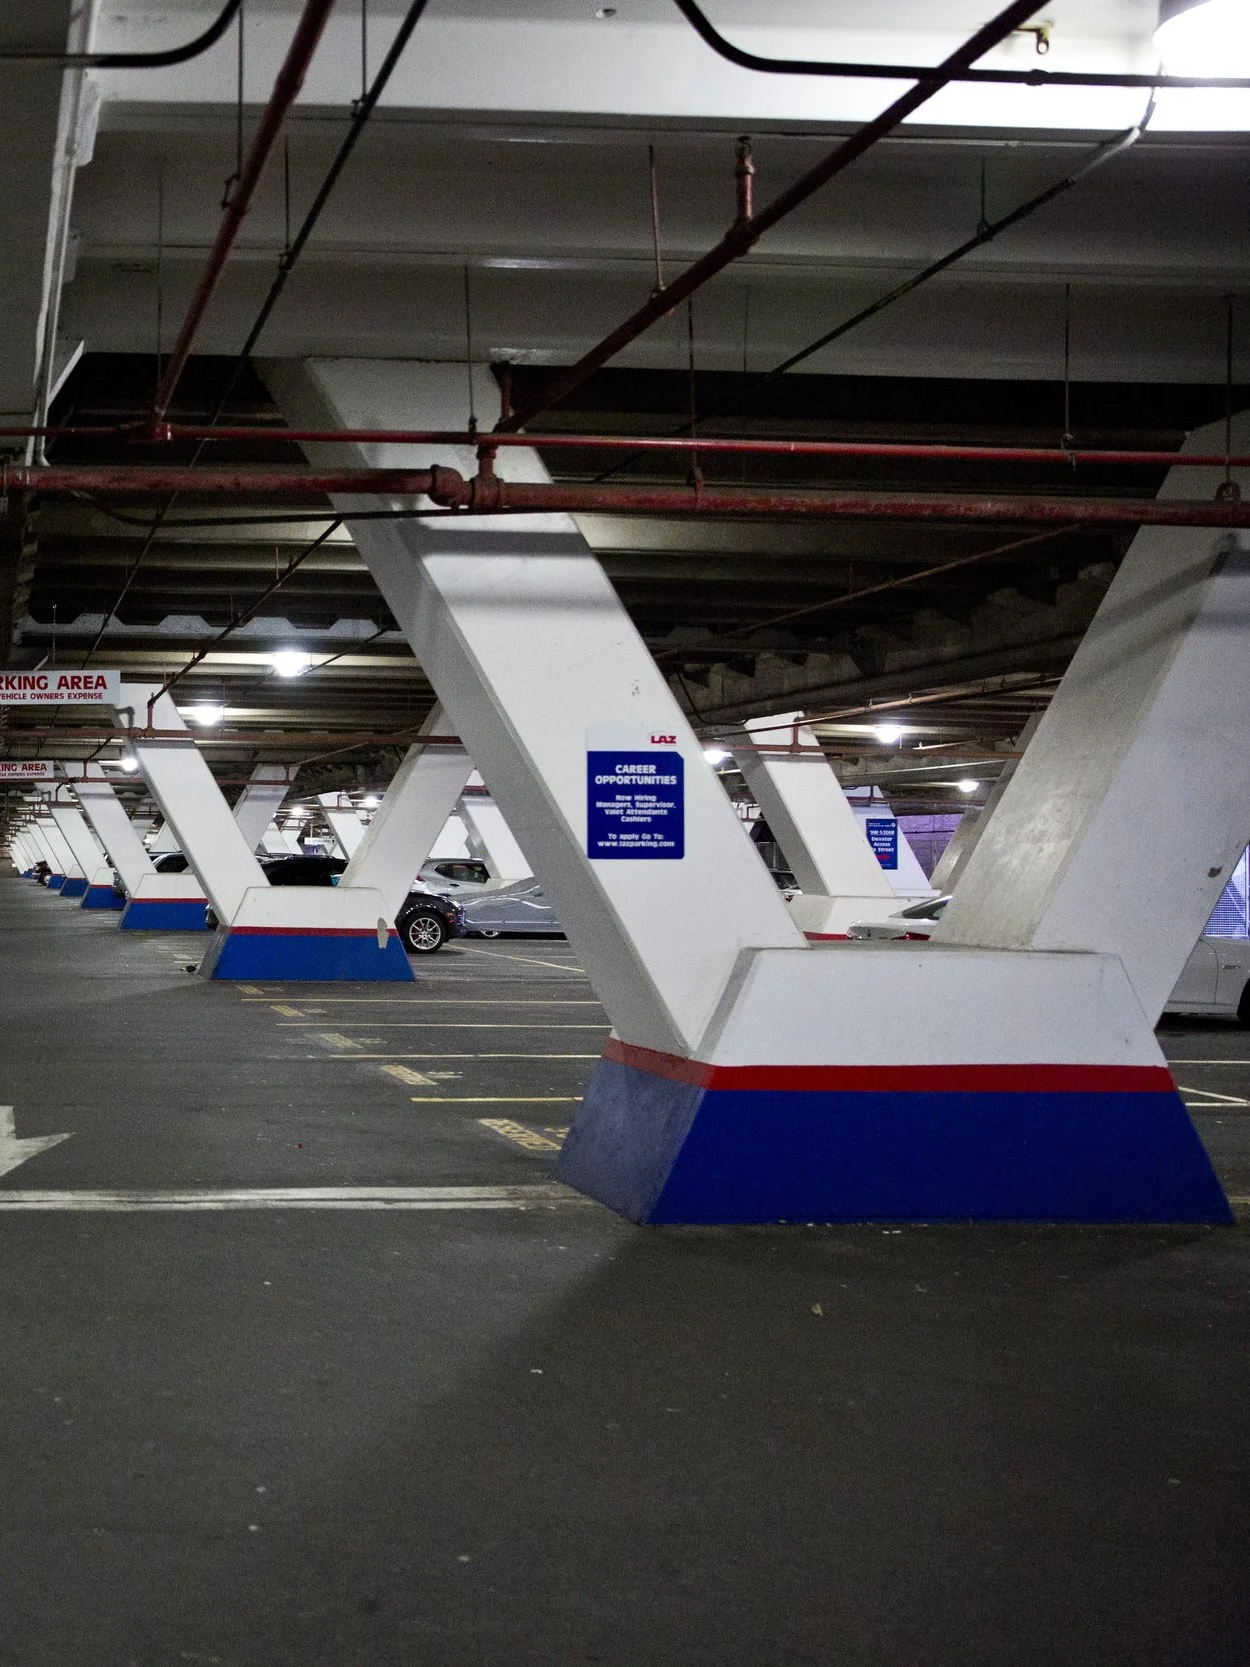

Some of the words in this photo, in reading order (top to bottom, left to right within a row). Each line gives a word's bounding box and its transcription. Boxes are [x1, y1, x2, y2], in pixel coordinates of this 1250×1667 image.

[57, 676, 107, 689] AREA
[651, 735, 676, 744] LAZ
[616, 765, 656, 774] CAREER
[595, 775, 677, 784] OPPORTUNITIES
